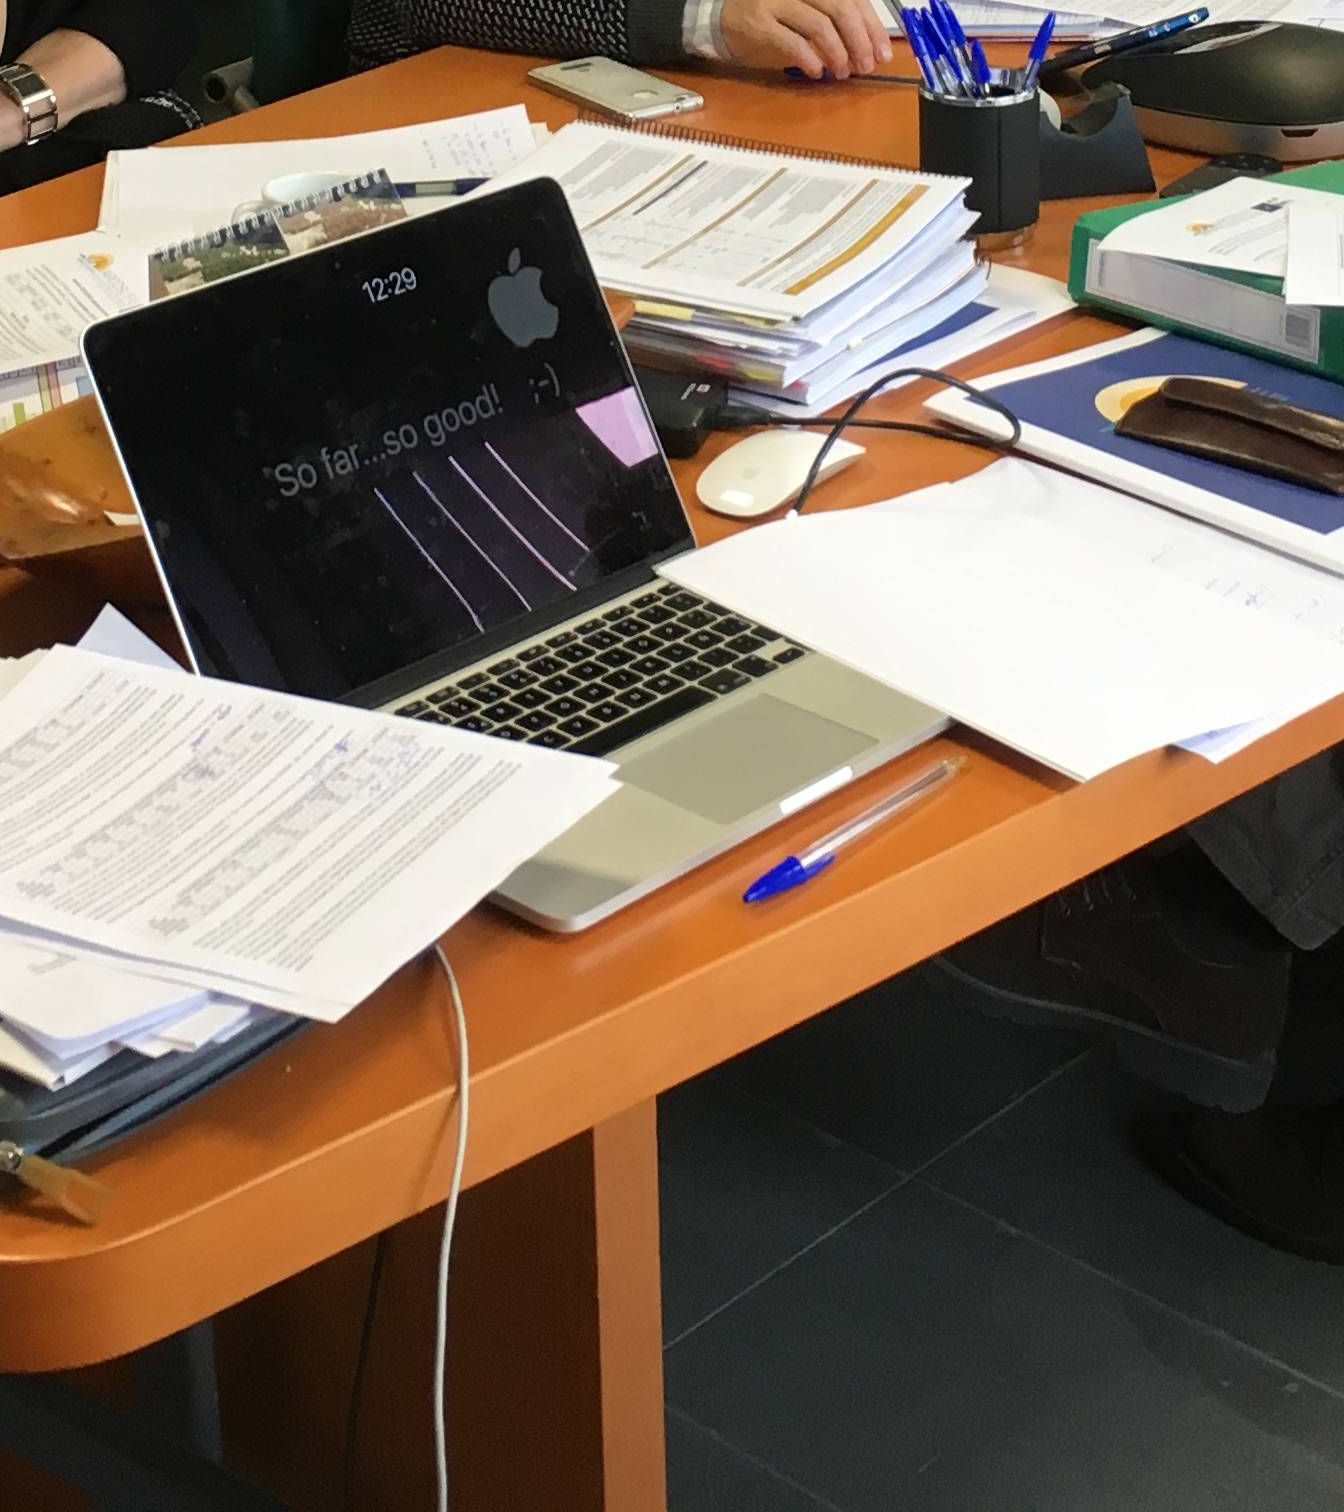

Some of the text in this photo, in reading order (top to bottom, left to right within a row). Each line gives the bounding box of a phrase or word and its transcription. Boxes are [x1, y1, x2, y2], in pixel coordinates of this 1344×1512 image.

[362, 267, 417, 303] 12:29
[275, 362, 560, 497] So far...so good! ;-)
